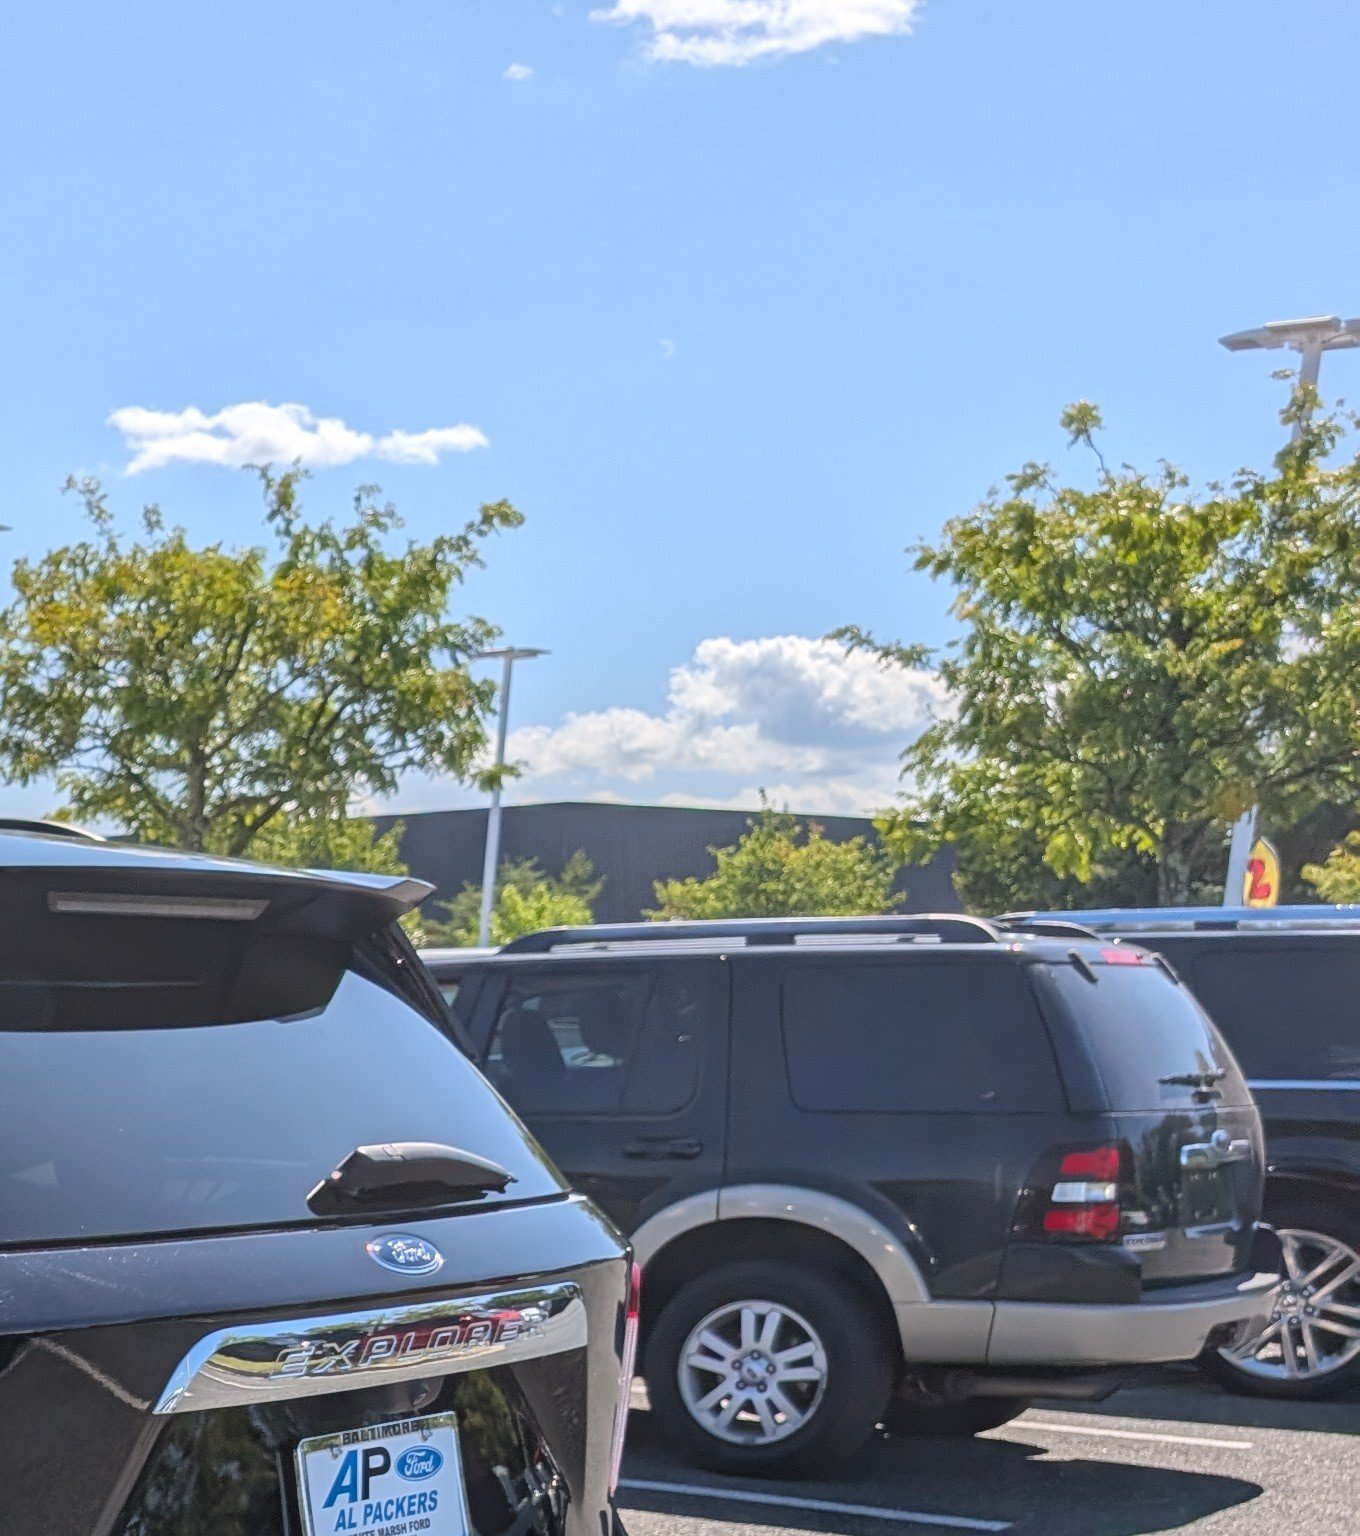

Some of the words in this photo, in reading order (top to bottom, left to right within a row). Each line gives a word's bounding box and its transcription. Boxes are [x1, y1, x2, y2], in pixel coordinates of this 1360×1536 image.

[342, 1421, 420, 1446] BALTIMORE
[403, 1450, 435, 1477] Ford
[322, 1446, 391, 1509] AP
[334, 1507, 357, 1532] AL
[362, 1489, 438, 1526] PACKERS
[408, 1517, 431, 1533] FORD
